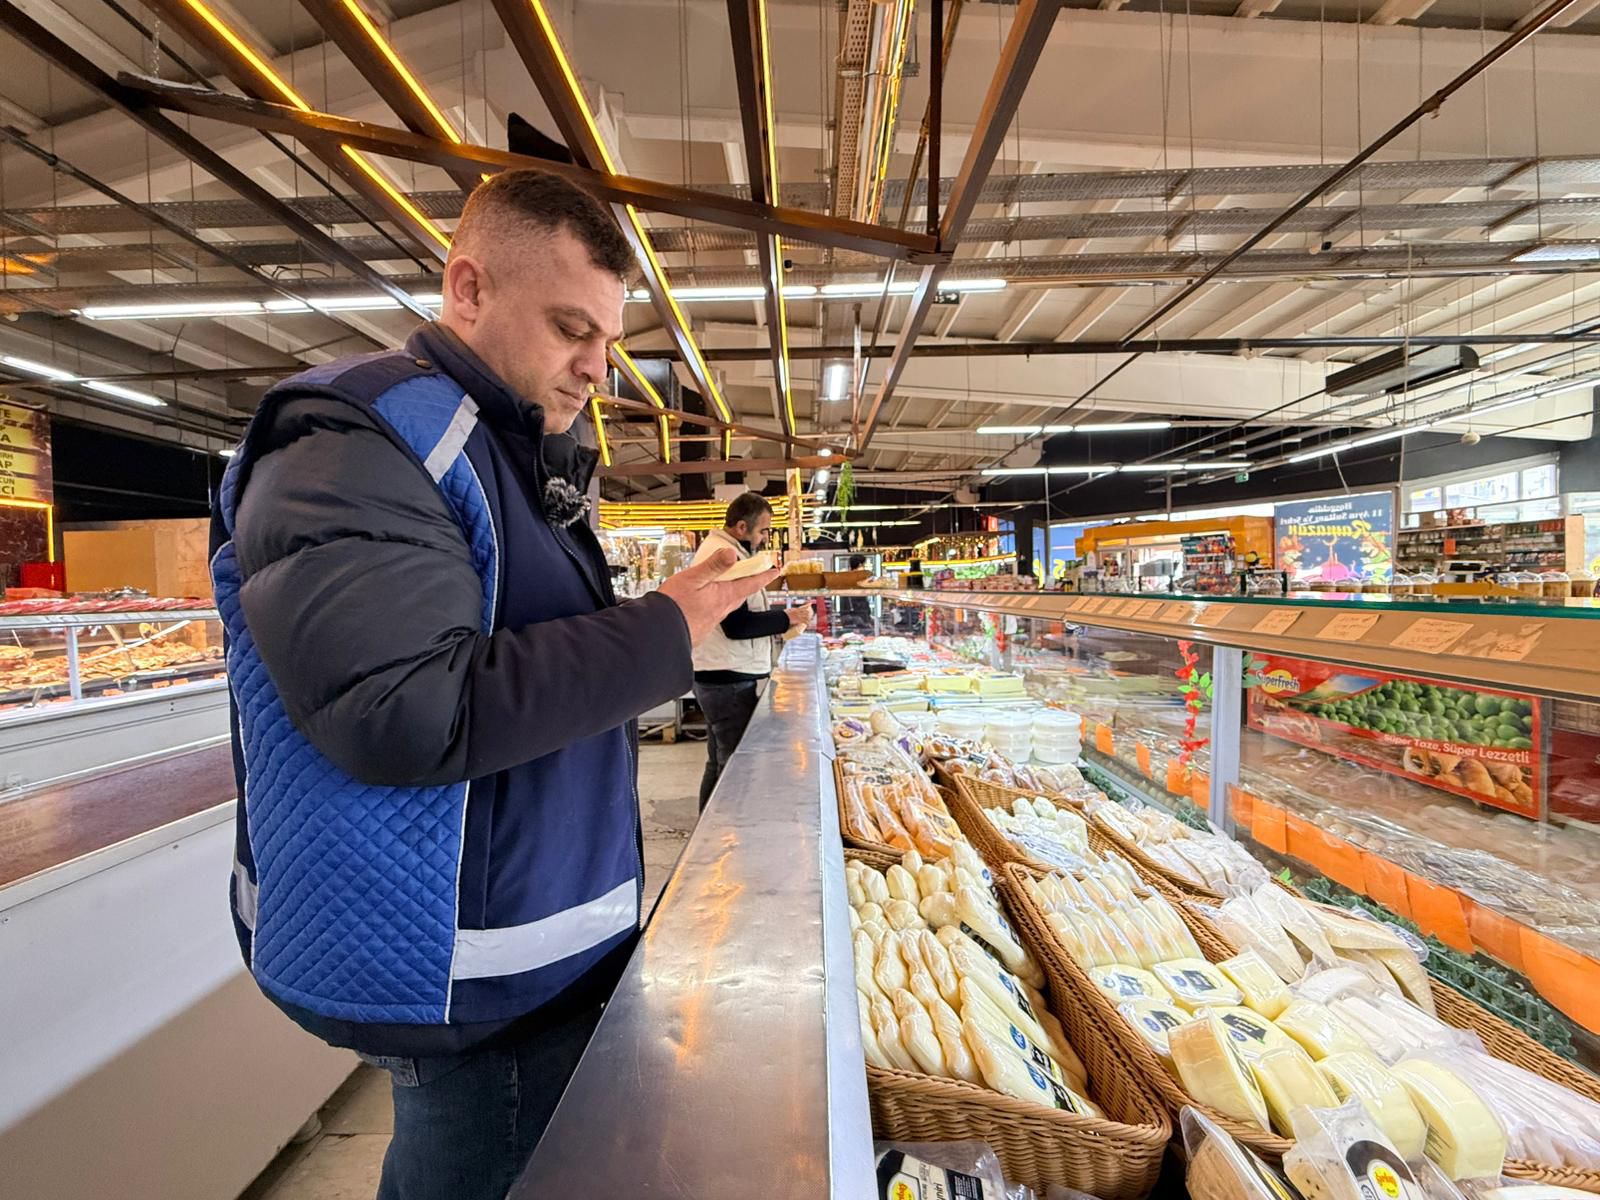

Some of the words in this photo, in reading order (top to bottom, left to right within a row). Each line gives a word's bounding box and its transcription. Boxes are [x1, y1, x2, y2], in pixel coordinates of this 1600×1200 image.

[1384, 733, 1412, 746] Süper
[1414, 738, 1441, 752] Taze,
[1443, 742, 1477, 758] Süper
[1479, 747, 1529, 764] Lezzetli
